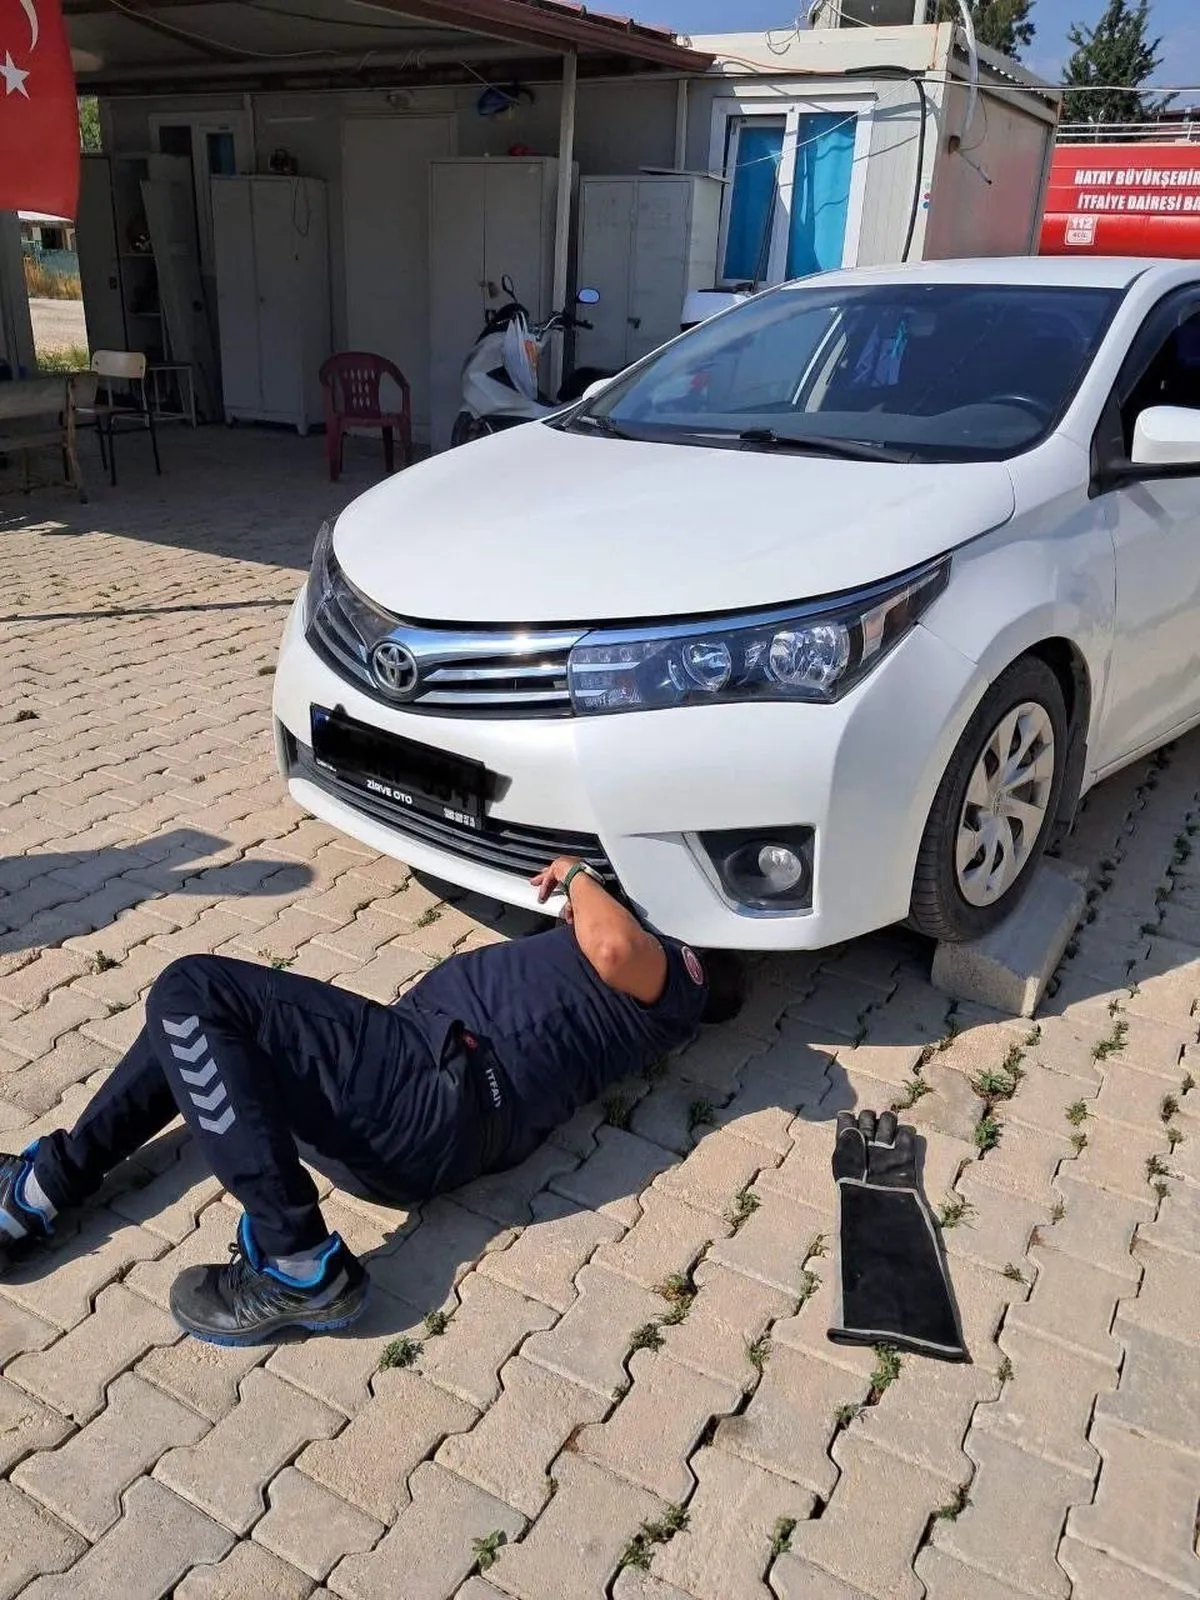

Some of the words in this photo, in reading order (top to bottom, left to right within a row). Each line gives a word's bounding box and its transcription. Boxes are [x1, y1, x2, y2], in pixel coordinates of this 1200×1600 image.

[1075, 169, 1115, 185] HATAY
[1077, 192, 1126, 209] İTFAİYE
[1127, 193, 1182, 211] DAİRESİ
[393, 790, 412, 805] OTO
